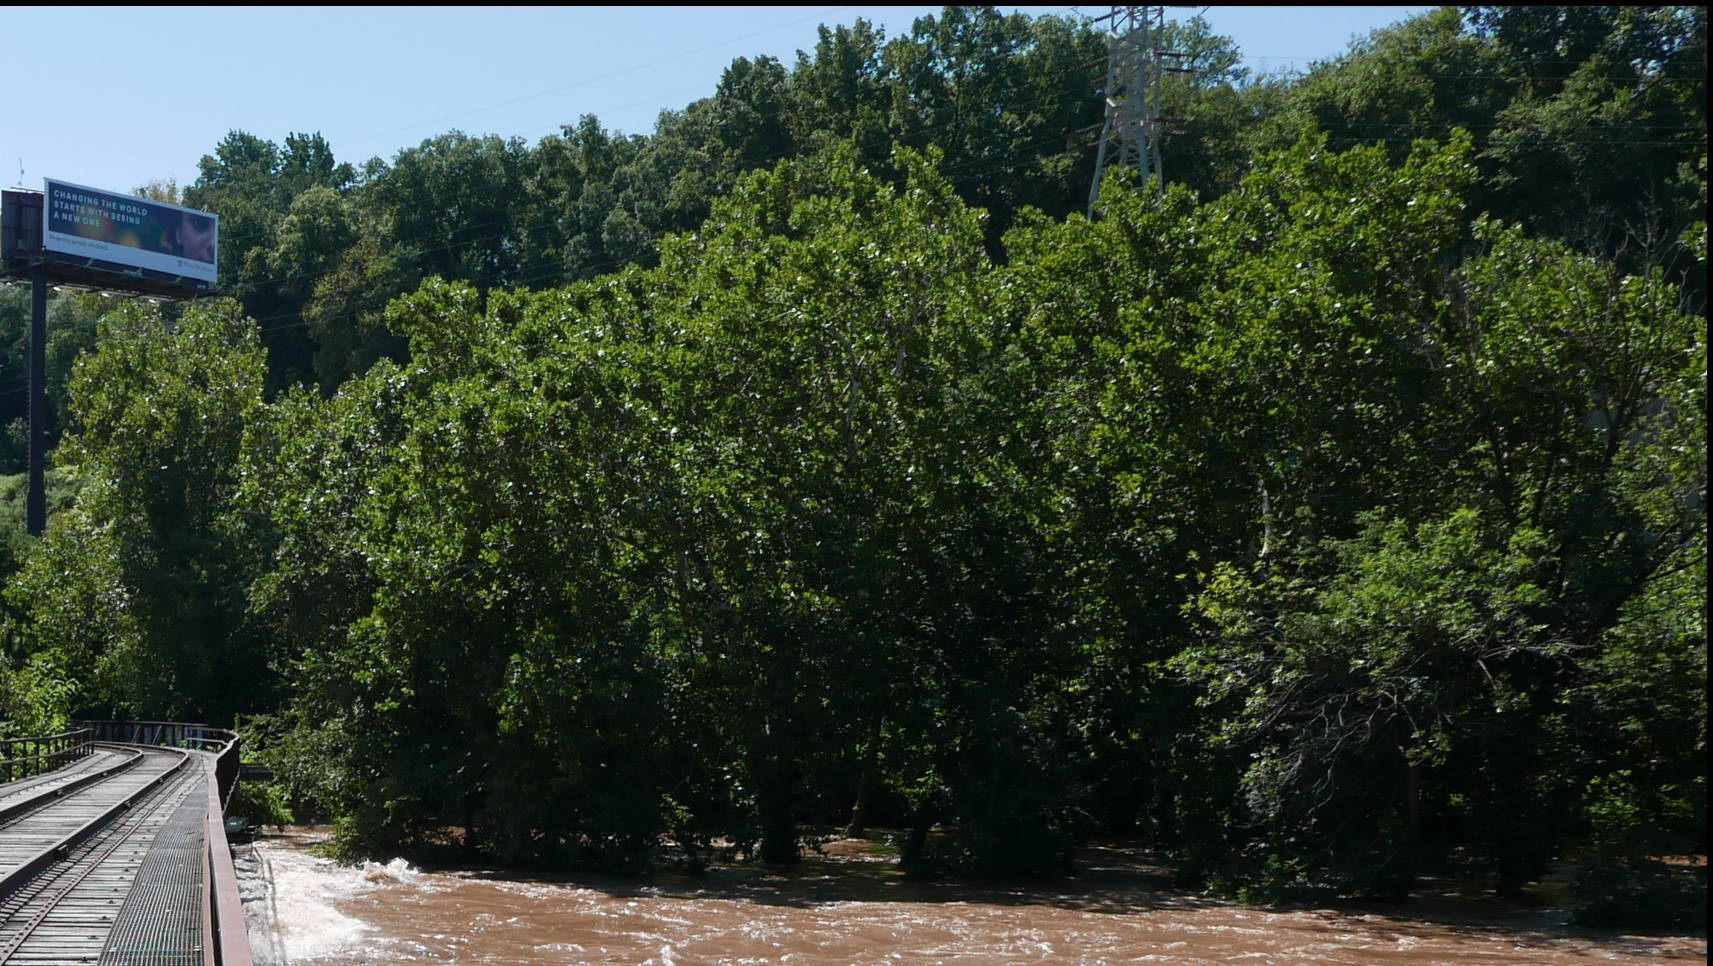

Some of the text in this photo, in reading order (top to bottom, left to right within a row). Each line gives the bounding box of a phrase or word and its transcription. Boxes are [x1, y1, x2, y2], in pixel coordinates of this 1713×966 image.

[54, 189, 148, 217] CHANGING THE WORLD
[54, 200, 85, 214] STARTS
[88, 207, 109, 219] WITH
[53, 211, 100, 228] A NEW ONE
